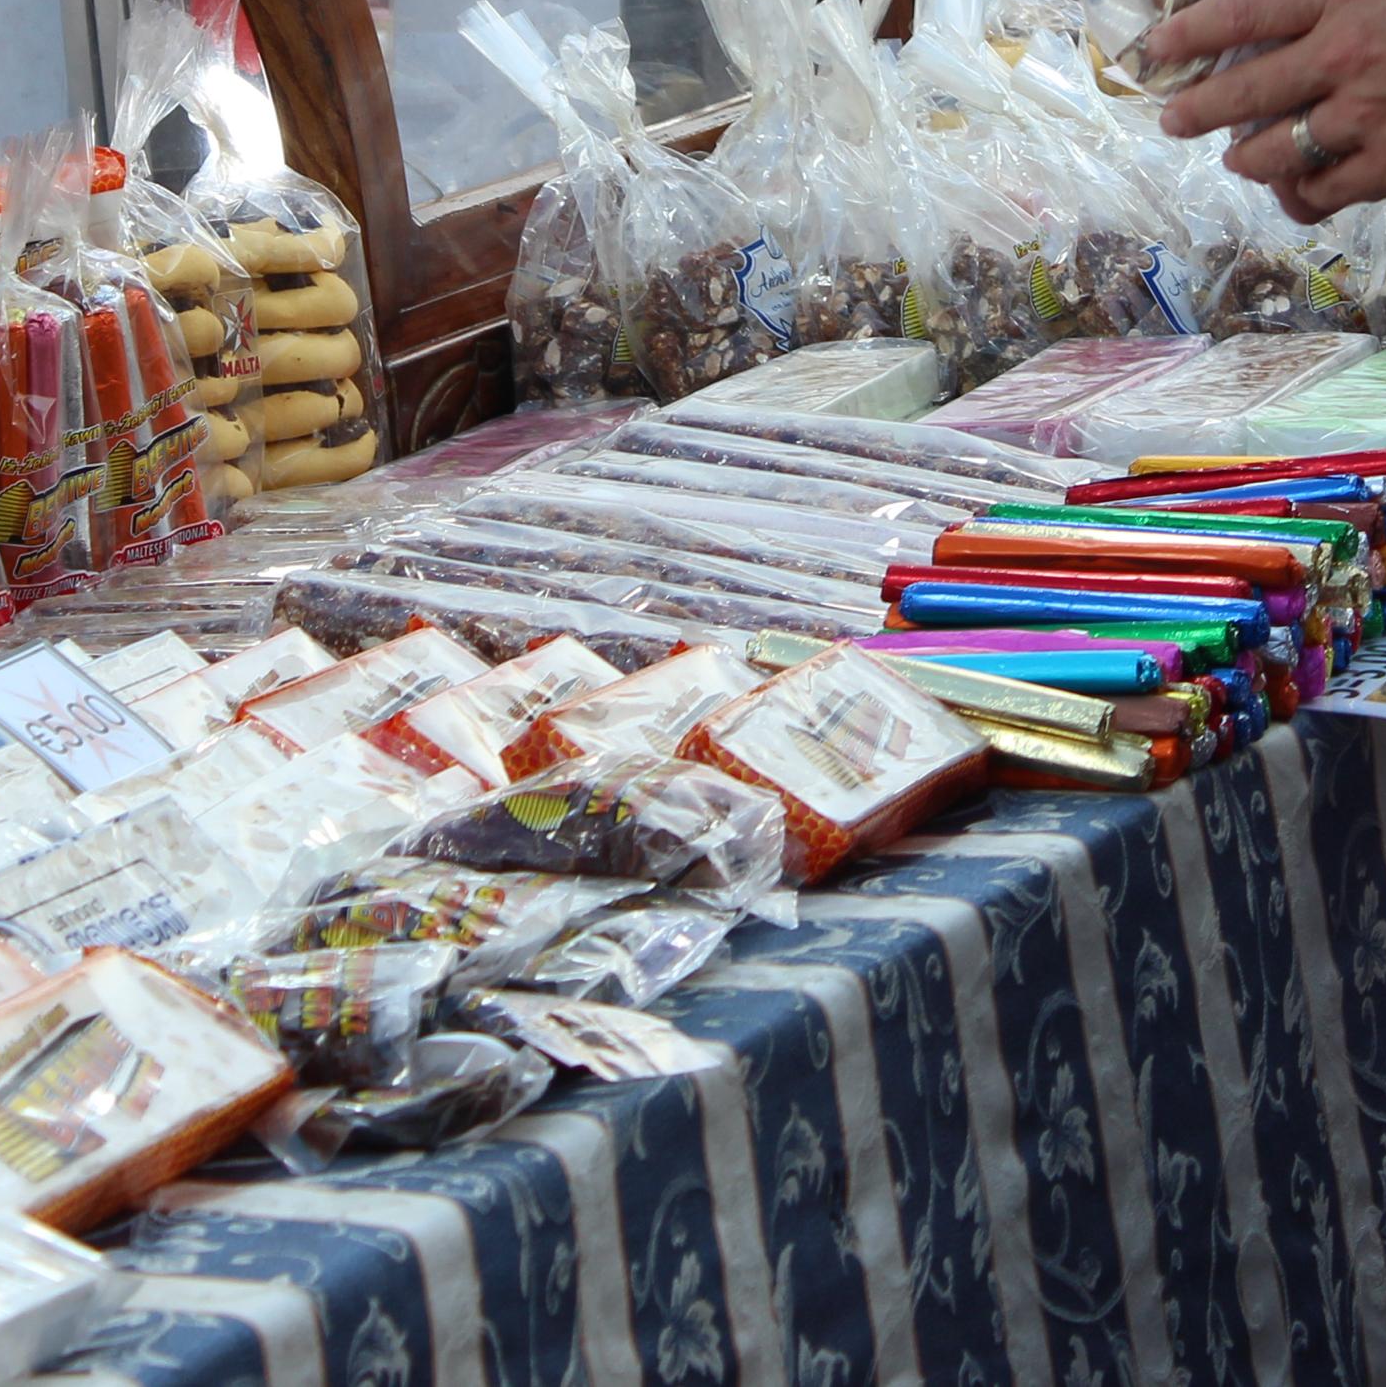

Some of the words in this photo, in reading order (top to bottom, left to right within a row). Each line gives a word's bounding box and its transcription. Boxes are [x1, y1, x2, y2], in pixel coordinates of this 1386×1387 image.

[222, 355, 261, 378] MALTA
[126, 544, 163, 561] MALTESE
[12, 588, 41, 601] ALTESE
[25, 694, 127, 755] €5.00
